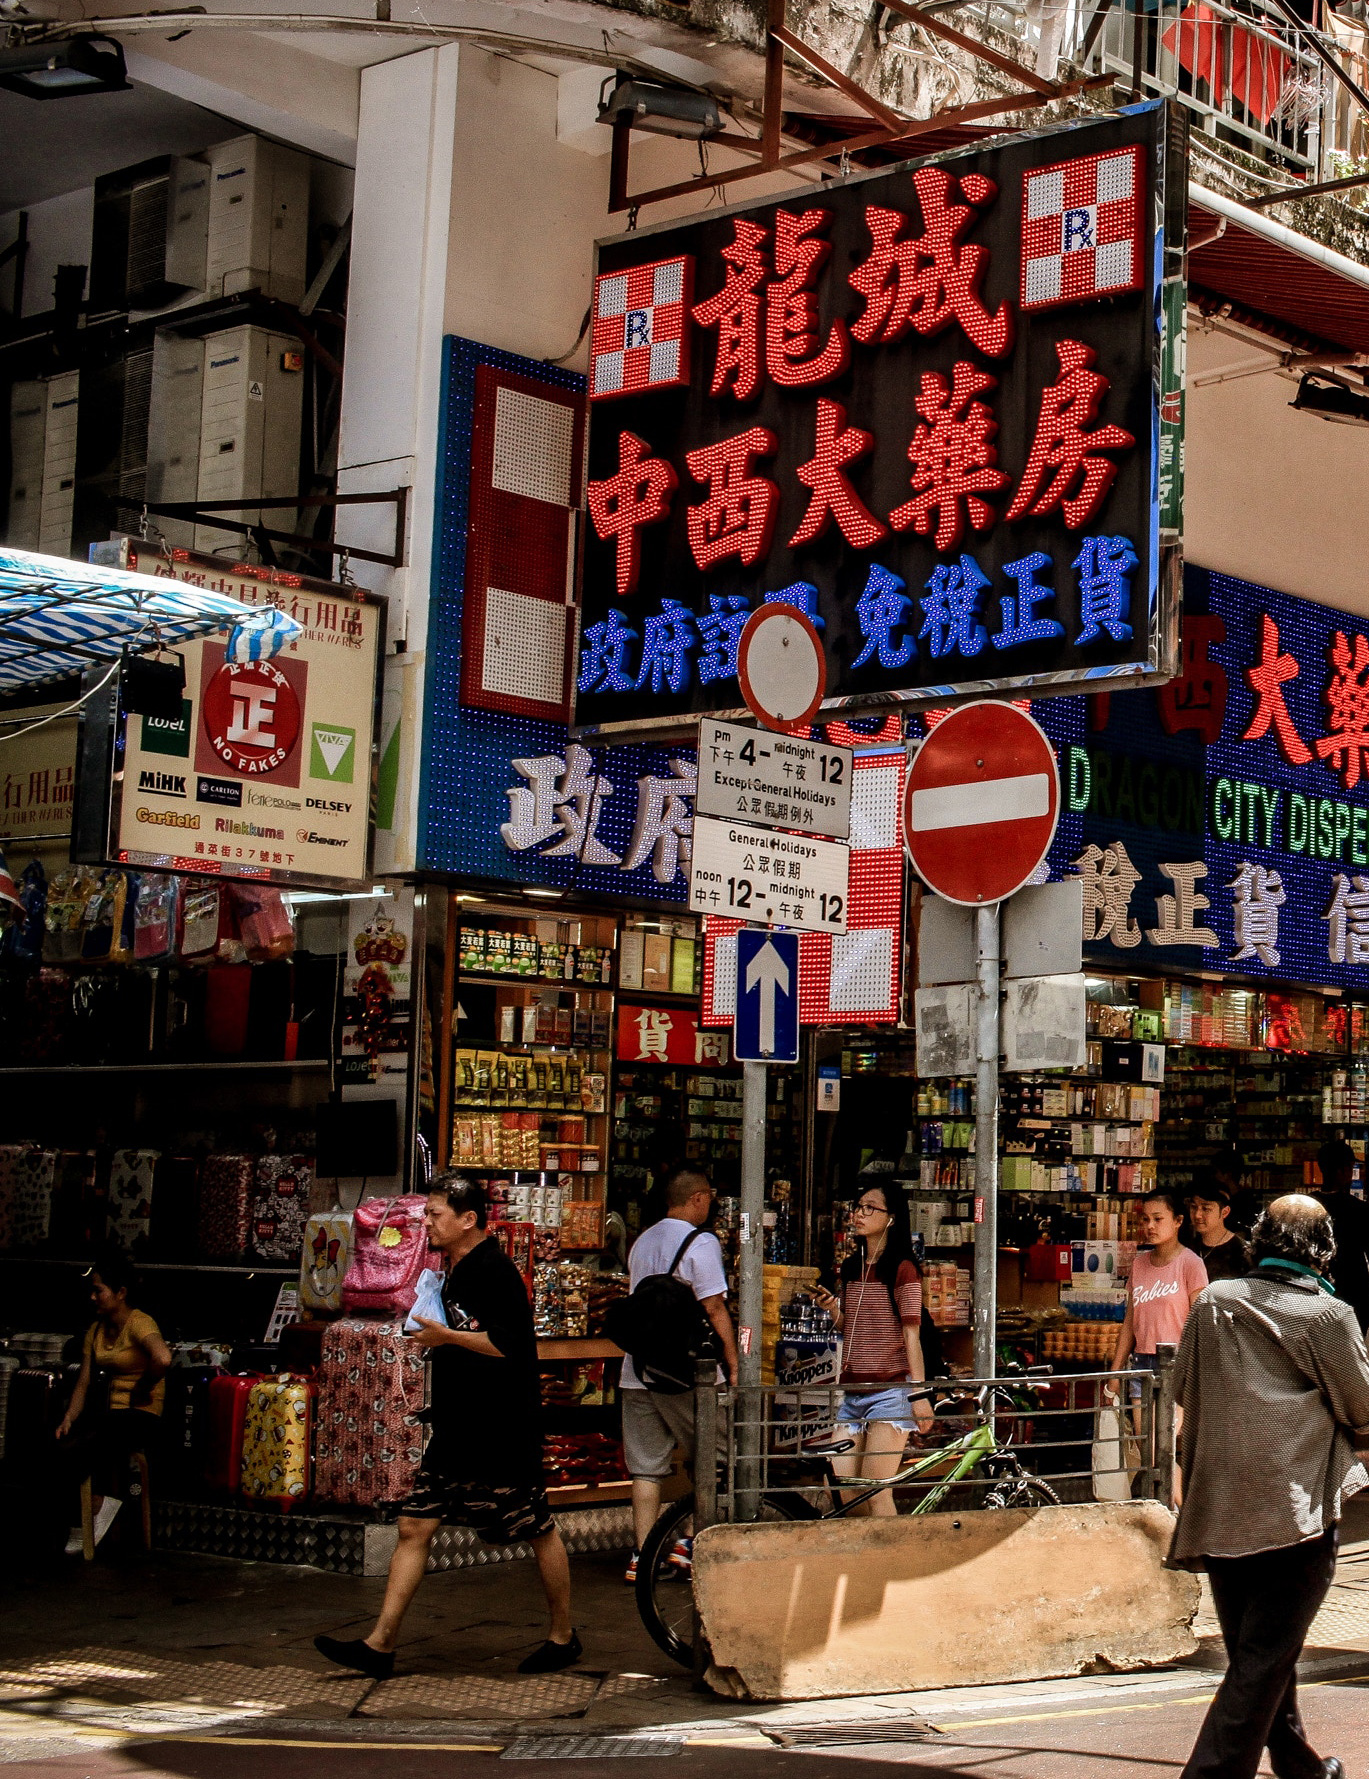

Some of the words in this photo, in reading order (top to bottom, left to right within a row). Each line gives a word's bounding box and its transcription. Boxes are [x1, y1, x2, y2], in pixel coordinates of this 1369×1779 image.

[692, 167, 1011, 400] 龍城
[588, 338, 1135, 596] 中西大藥房
[851, 535, 1140, 670] 免稅正貨
[226, 681, 278, 749] 正
[213, 736, 232, 761] NO
[237, 747, 286, 774] FAKES
[715, 729, 731, 743] pm
[774, 742, 815, 760] midnight
[709, 745, 735, 766] 下午
[782, 761, 807, 781] 午夜
[819, 754, 844, 785] 12
[138, 770, 187, 795] MiHK
[210, 785, 240, 796] CARLTON
[714, 770, 751, 791] Except
[753, 778, 792, 798] General
[793, 786, 836, 807] Holidays
[1069, 745, 1203, 836] DRAGON
[1213, 777, 1280, 848] CITY
[136, 807, 200, 830] Garfield
[306, 798, 352, 813] DELSEY
[736, 795, 814, 826] 公眾假期例外
[215, 818, 285, 840] Rilakkuma
[729, 830, 770, 849] General
[773, 838, 817, 859] Holidays
[743, 853, 801, 880] 公眾假期
[696, 869, 722, 883] noon
[769, 882, 815, 899] midnight
[695, 887, 721, 907] 中午
[778, 901, 805, 921] 午夜
[819, 892, 844, 924] 12
[1133, 1280, 1179, 1308] Babies
[780, 1360, 833, 1386] Knoppers
